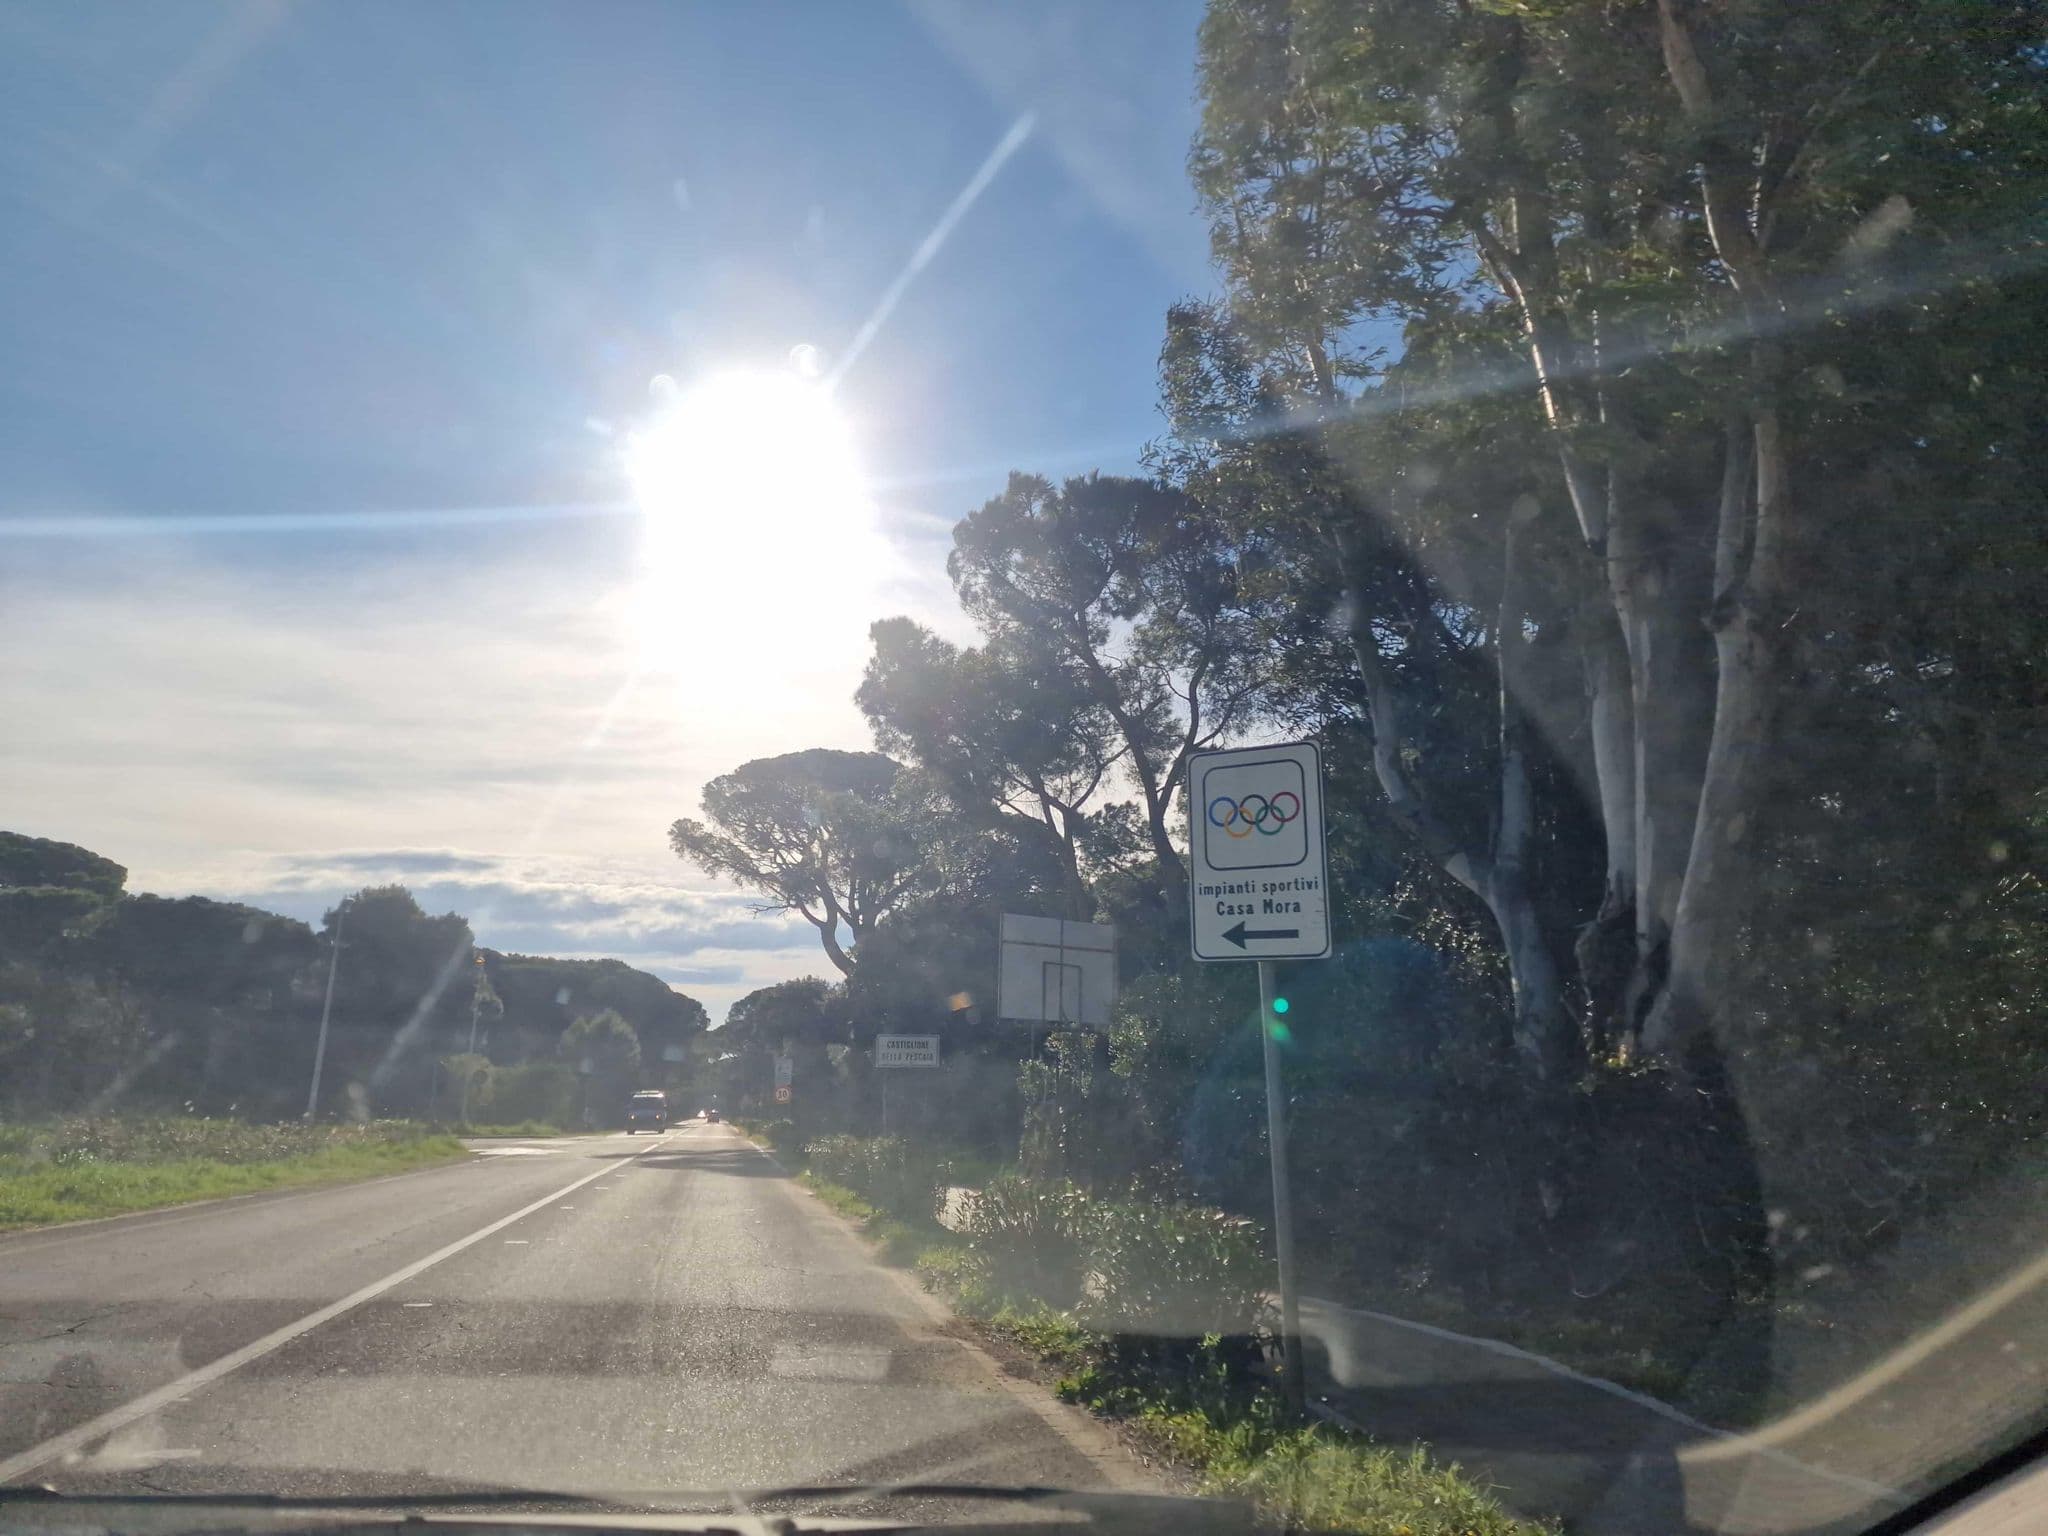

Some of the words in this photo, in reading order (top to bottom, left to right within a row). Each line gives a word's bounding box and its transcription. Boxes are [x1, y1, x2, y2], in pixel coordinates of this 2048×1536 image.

[1199, 880, 1256, 898] impianti
[1262, 877, 1319, 895] sportivi
[1216, 901, 1254, 915] Casa
[1263, 899, 1301, 914] Mora
